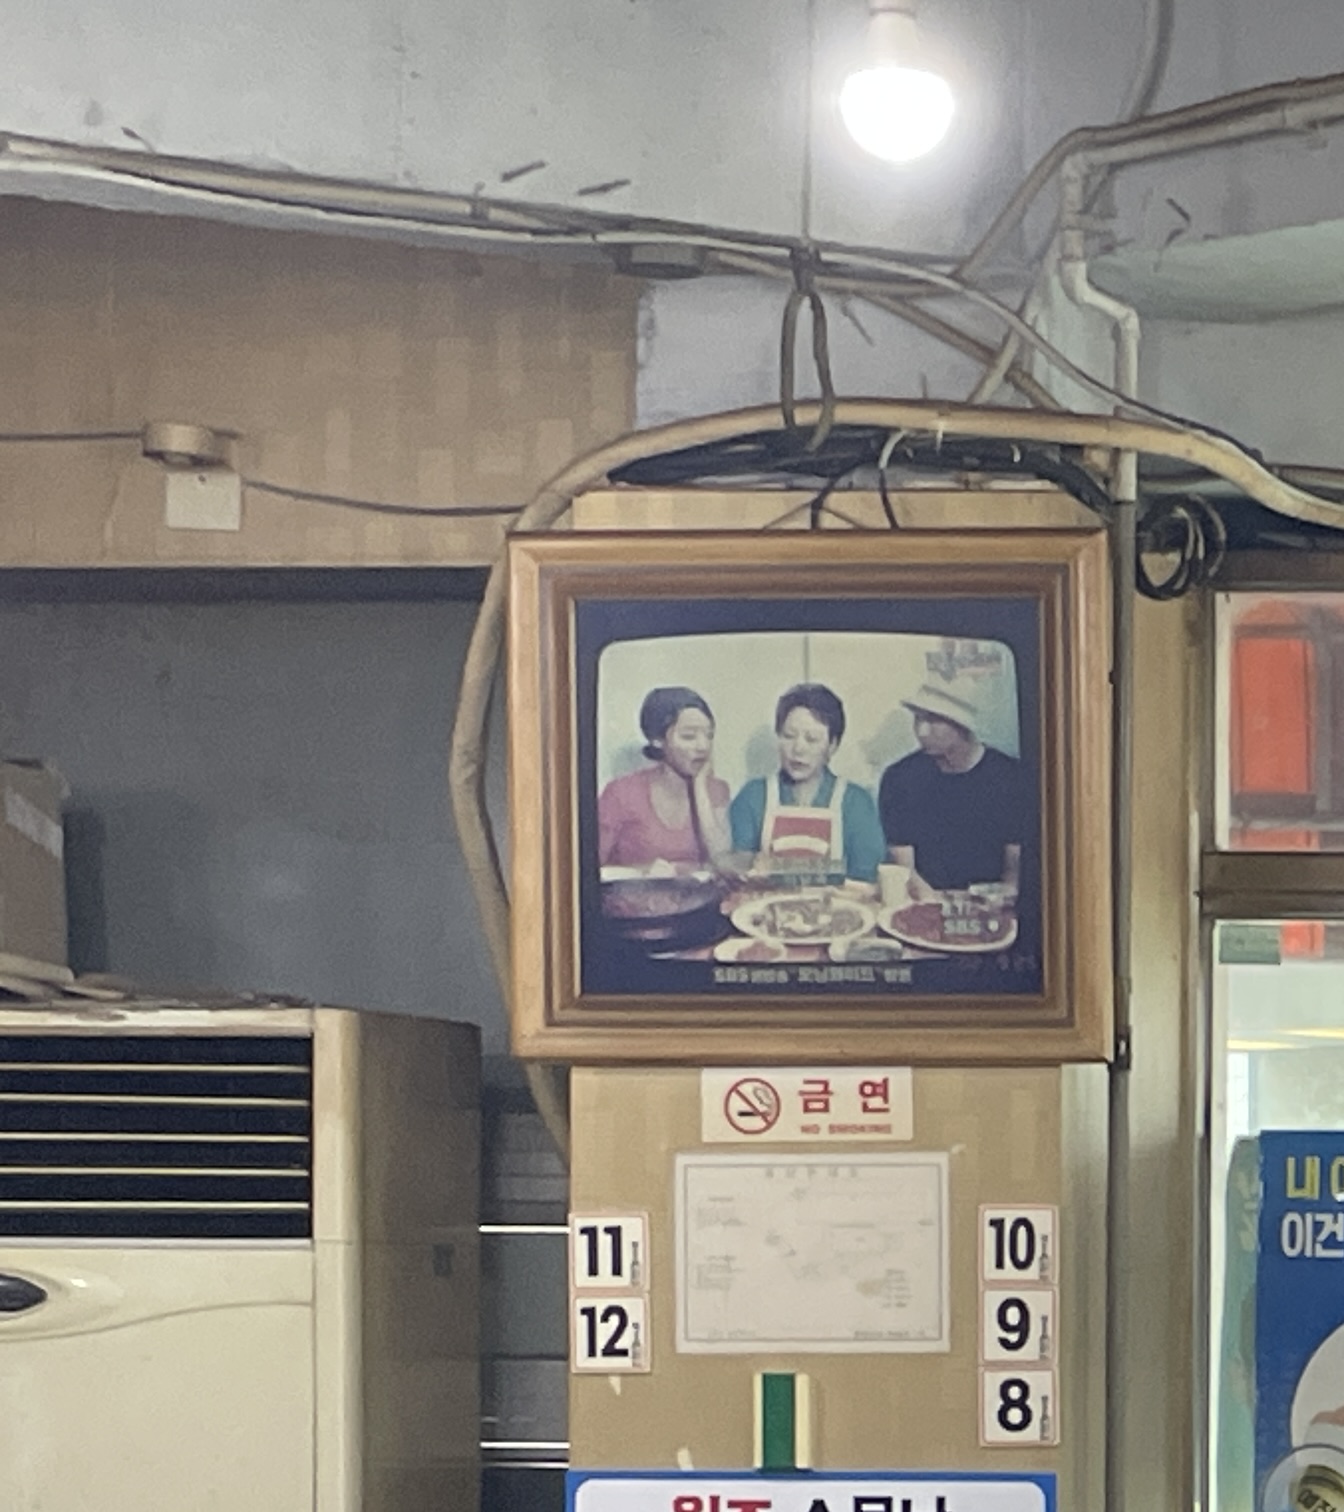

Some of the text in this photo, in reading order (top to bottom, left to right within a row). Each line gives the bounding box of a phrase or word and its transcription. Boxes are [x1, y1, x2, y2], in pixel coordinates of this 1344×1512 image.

[798, 1077, 890, 1114] 금 연
[1285, 1155, 1321, 1201] 내
[579, 1225, 623, 1277] 11
[988, 1216, 1036, 1271] 10
[580, 1304, 629, 1358] 12
[997, 1297, 1031, 1352] 9
[997, 1377, 1033, 1432] 8
